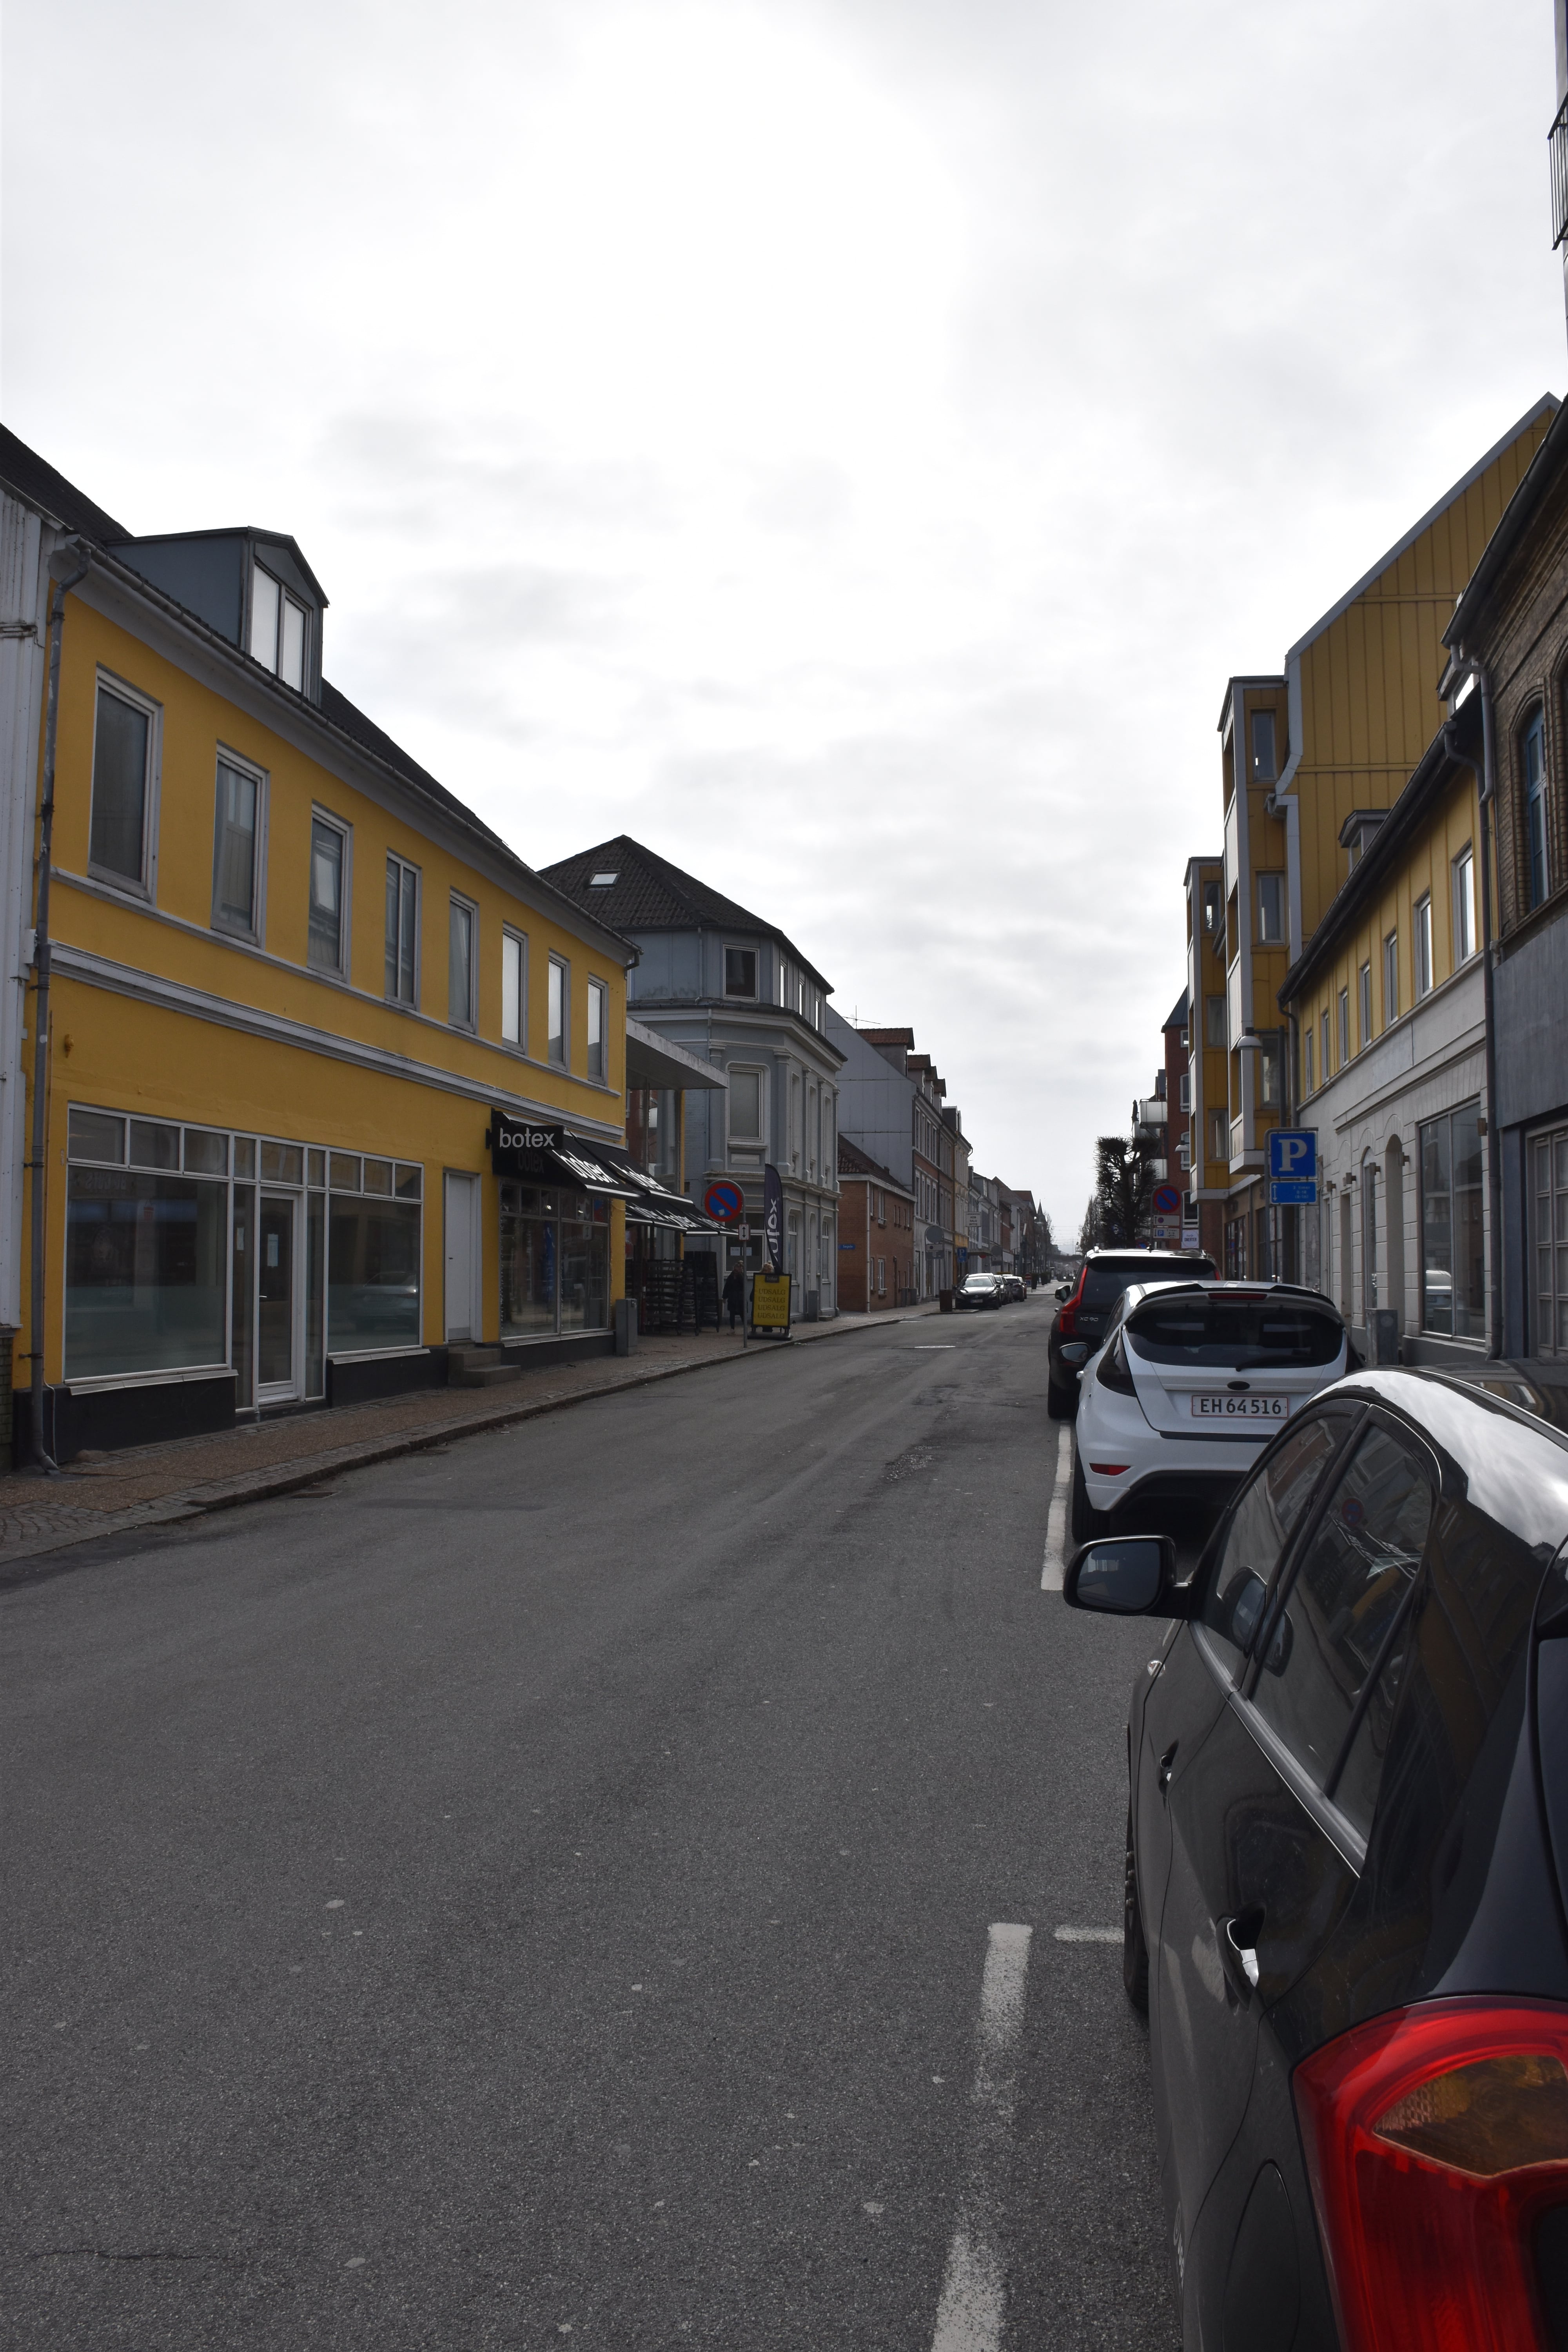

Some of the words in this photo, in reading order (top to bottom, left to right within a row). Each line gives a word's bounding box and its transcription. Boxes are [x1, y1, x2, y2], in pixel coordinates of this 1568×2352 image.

[499, 1127, 554, 1148] botex
[552, 1149, 619, 1184] botex
[1278, 1139, 1307, 1171] P
[609, 1160, 671, 1193] botex
